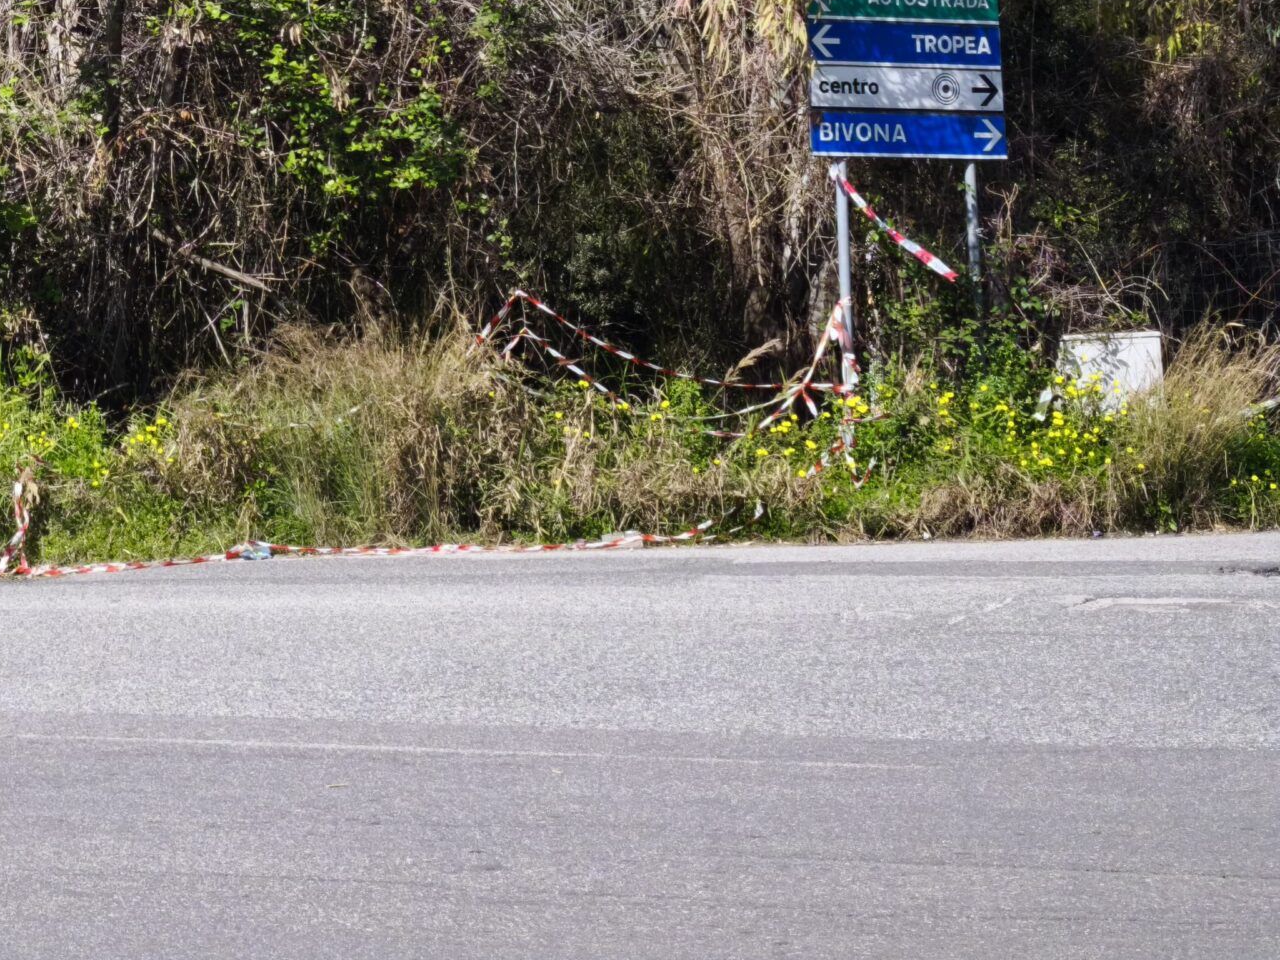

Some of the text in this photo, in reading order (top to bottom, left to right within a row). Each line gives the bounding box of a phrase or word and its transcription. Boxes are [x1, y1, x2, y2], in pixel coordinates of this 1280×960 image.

[911, 34, 992, 55] TROPEA
[819, 78, 880, 95] centro
[819, 122, 907, 143] BIVONA
